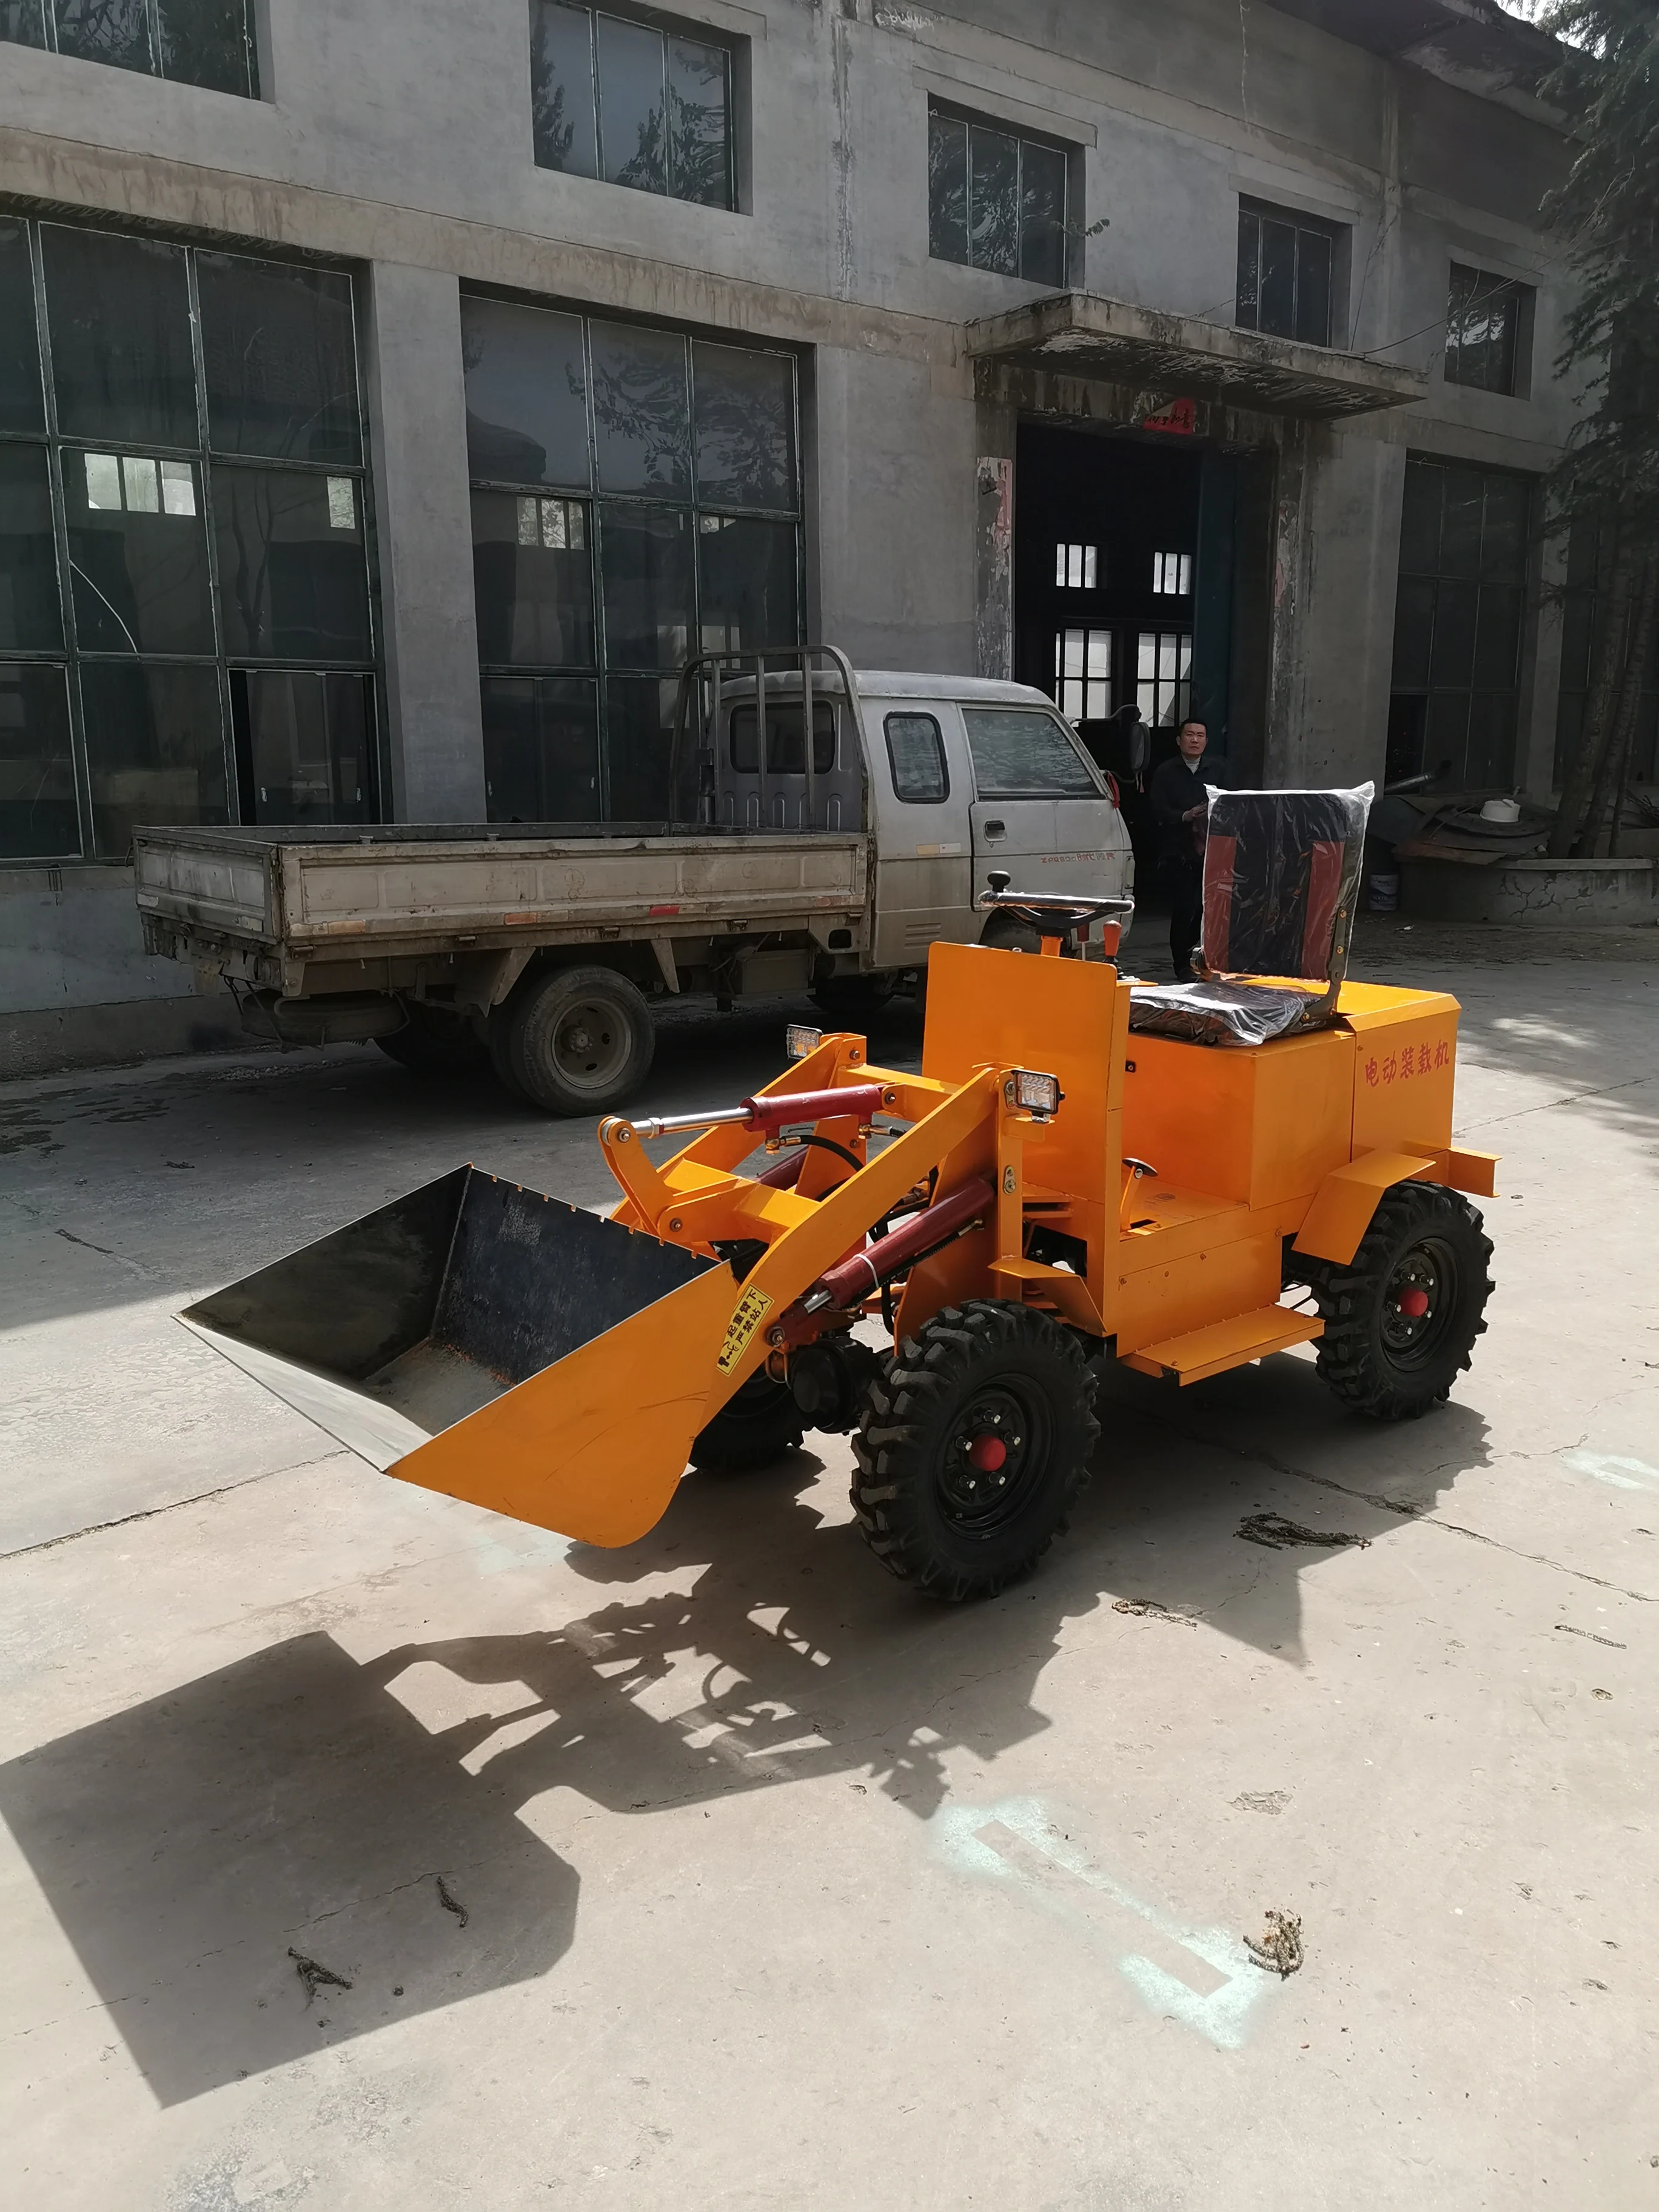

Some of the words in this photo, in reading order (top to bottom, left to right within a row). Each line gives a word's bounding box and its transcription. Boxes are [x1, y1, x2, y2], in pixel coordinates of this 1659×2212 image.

[1365, 1039, 1450, 1087] 电动装载机
[728, 1289, 757, 1338] 起重臂下
[736, 1299, 768, 1345] 严禁站人
